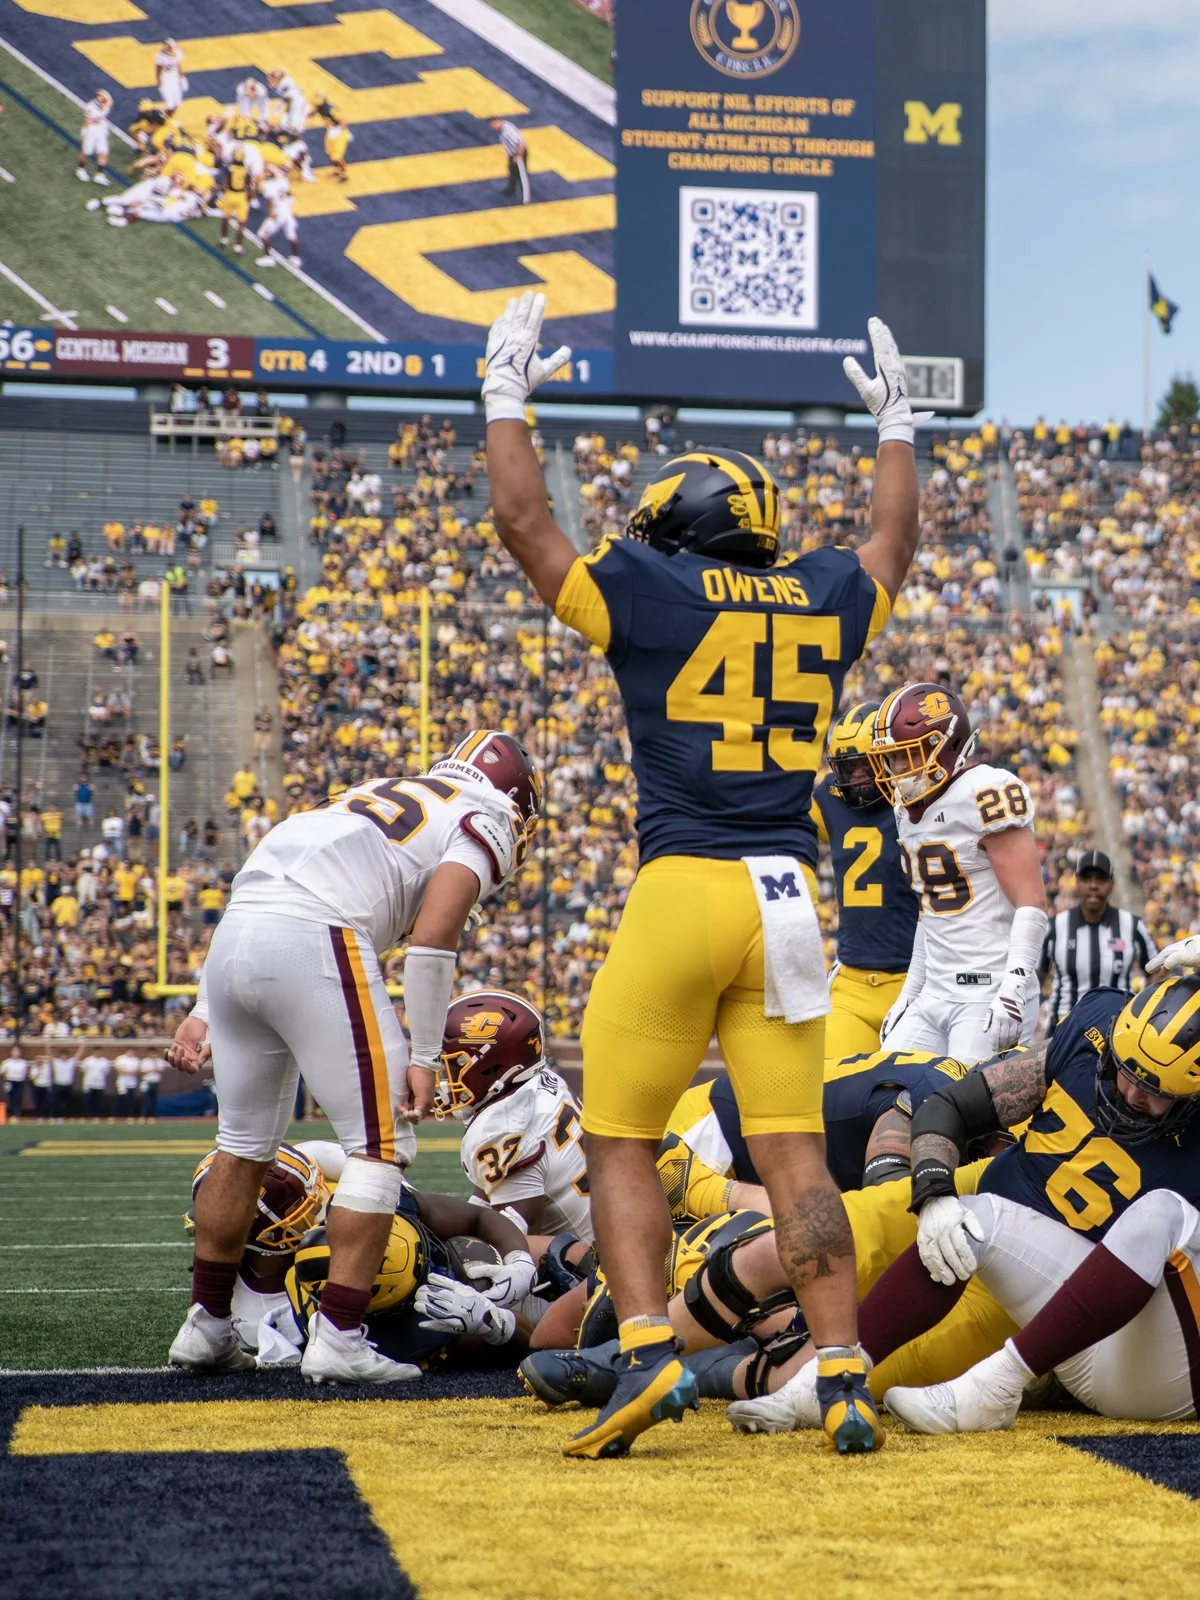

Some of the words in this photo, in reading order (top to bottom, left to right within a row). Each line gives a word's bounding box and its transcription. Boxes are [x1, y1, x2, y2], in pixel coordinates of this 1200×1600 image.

[642, 89, 721, 110] SUPPORT
[723, 93, 751, 111] NIL
[755, 95, 829, 116] EFFORTS
[832, 99, 856, 117] OF
[688, 112, 721, 131] ALL
[723, 115, 810, 134] MICHIGAN
[904, 100, 962, 145] M
[793, 137, 875, 158] THROUGH
[668, 152, 770, 173] CHAMPIONS
[773, 157, 834, 177] CIRCLE
[56, 337, 120, 362] CENTRAL
[122, 339, 188, 365] MICHIGAN
[206, 338, 230, 369] 3
[260, 349, 306, 373] QTR
[308, 350, 327, 373] 4
[346, 350, 403, 375] 2ND
[431, 354, 445, 377] 1
[577, 359, 590, 383] 1
[702, 567, 809, 607] OWENS
[666, 611, 840, 772] 45
[975, 783, 1029, 826] 28
[843, 827, 882, 907] 2
[760, 872, 801, 901] M
[1009, 1080, 1141, 1231] 76
